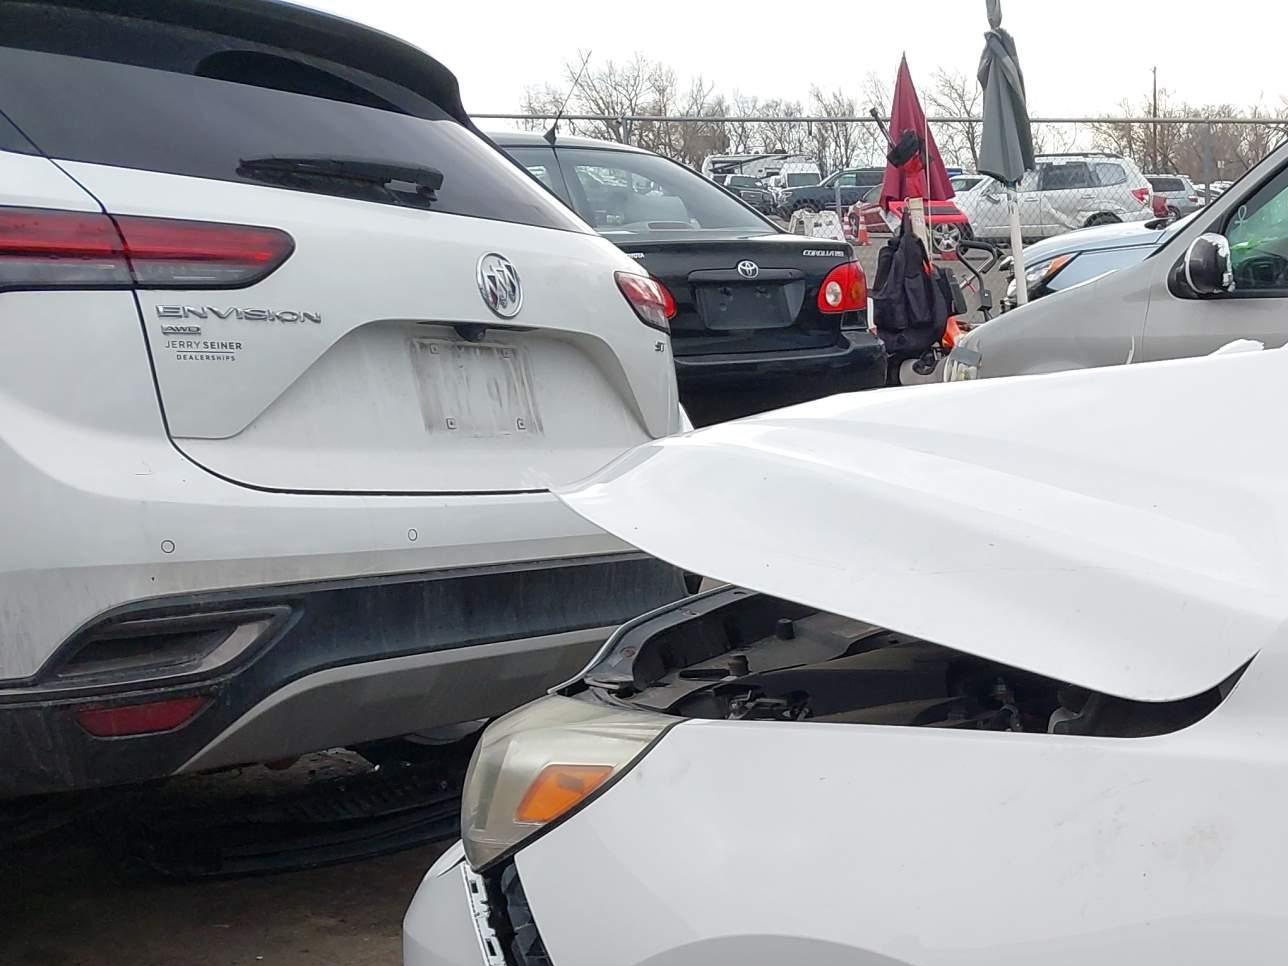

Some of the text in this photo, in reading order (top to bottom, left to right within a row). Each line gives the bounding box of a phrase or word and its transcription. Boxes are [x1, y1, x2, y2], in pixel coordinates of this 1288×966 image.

[156, 305, 321, 324] ENVISION
[162, 326, 201, 335] AWD
[165, 340, 242, 350] JERRY SEINER
[176, 354, 236, 362] DEALERSHIPS
